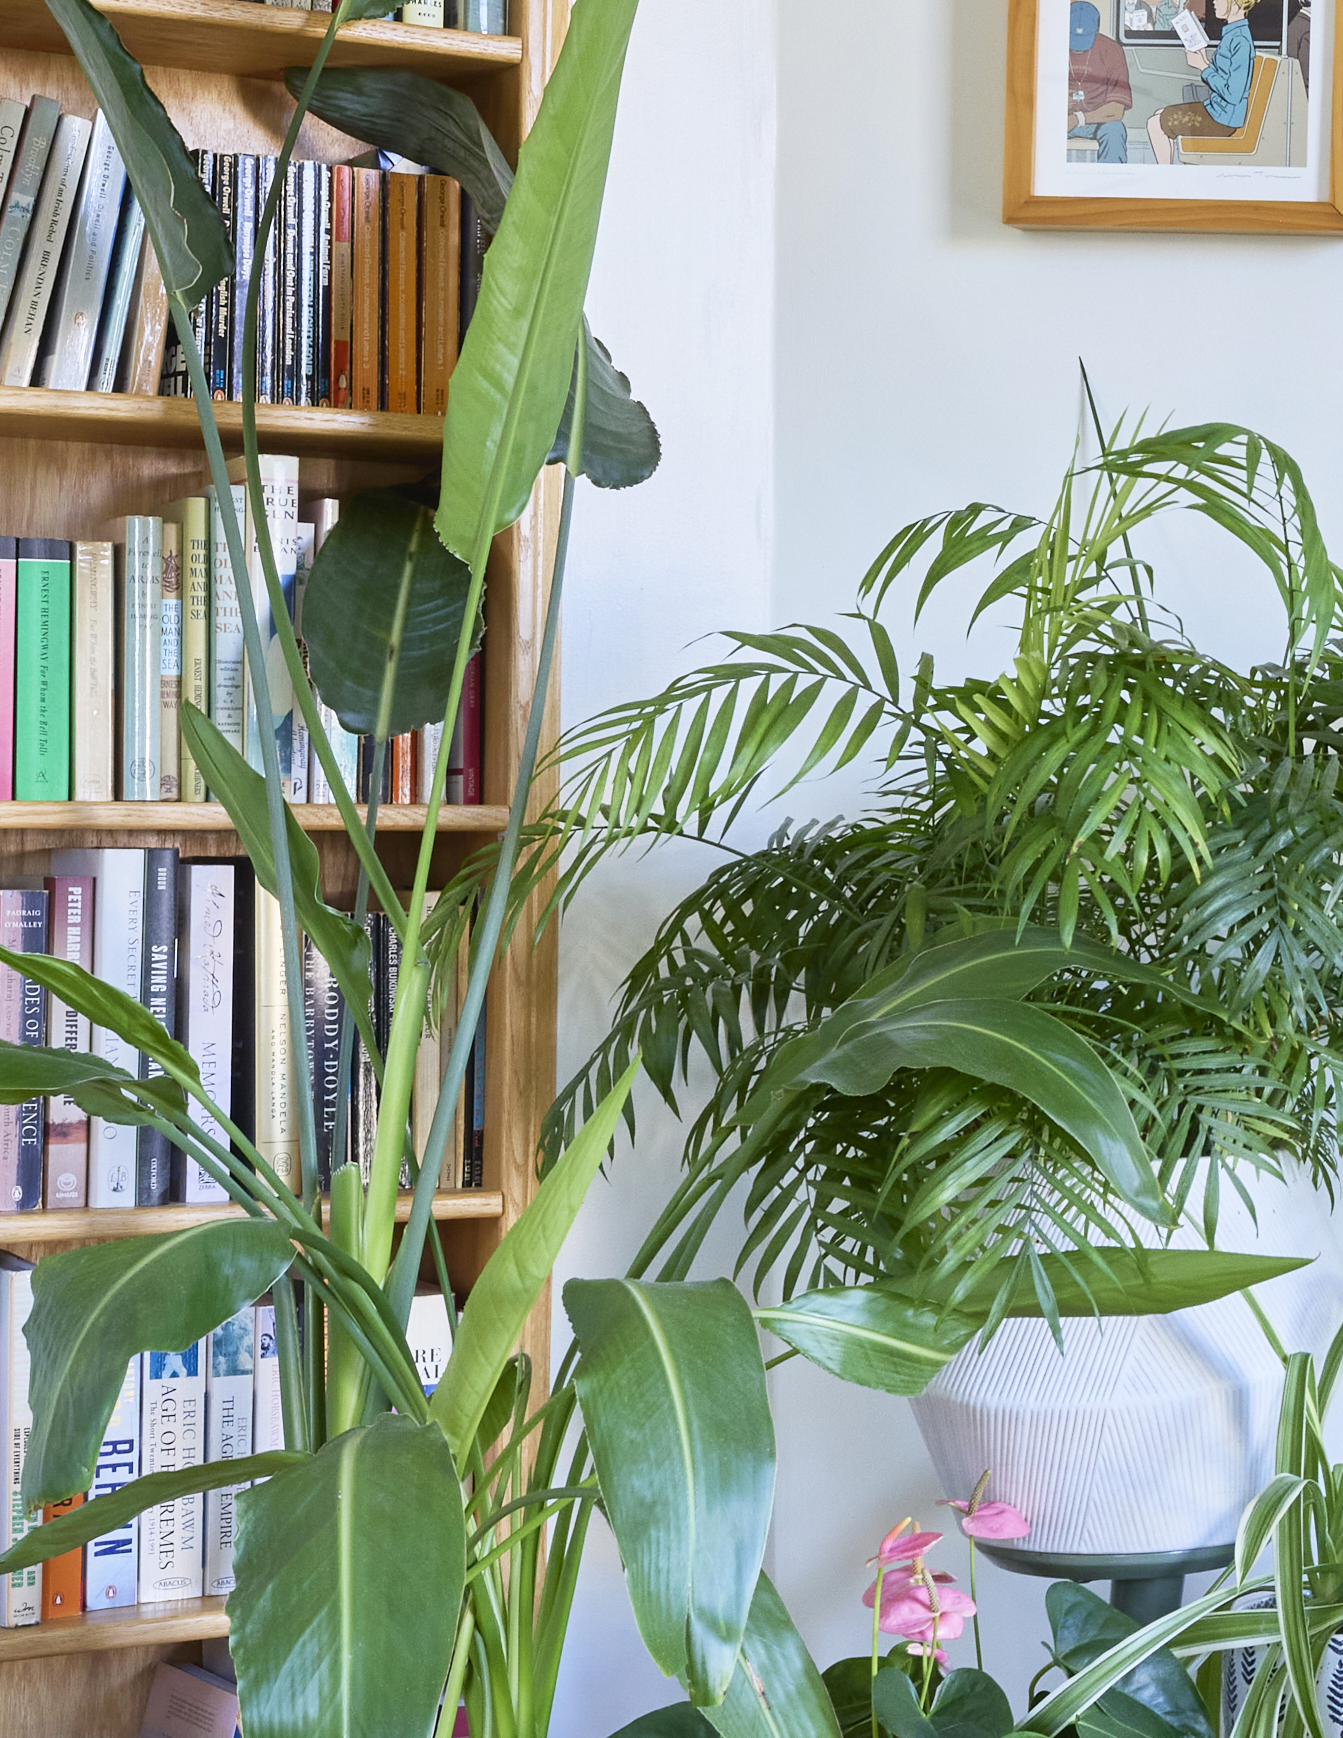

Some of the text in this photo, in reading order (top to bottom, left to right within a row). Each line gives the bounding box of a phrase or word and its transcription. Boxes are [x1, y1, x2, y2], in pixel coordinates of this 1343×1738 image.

[21, 136, 47, 186] Brooklyn
[221, 156, 231, 213] George Orwell
[84, 145, 115, 281] George Orwell Orwell and Politics
[241, 158, 254, 280] George Orwell Burmese Days
[23, 129, 81, 336] Confessions of an Irish Rebel BRENDAN BEHAN
[320, 171, 331, 285] George Orwell Animal Farm
[261, 485, 293, 495] THE
[190, 539, 208, 550] THE
[190, 555, 208, 565] OLD
[129, 575, 160, 584] ARMS
[190, 568, 208, 578] MAN
[190, 582, 208, 592] AND
[163, 603, 178, 612] THE
[190, 595, 208, 606] THE
[161, 614, 180, 625] OLD
[190, 609, 208, 620] SEA
[161, 627, 180, 636] MAN
[215, 623, 241, 633] SEA
[162, 638, 178, 646] AND
[163, 647, 178, 657] THE
[39, 571, 49, 756] ERNEST HEMINGWAY For Whom the Bell Tolls
[162, 659, 180, 670] SEA
[297, 724, 307, 769] Hemingway
[157, 868, 167, 891] BROUN
[127, 890, 140, 988] EVERY SECRET
[388, 927, 397, 1013] CHARLES BUKOWSKI
[323, 978, 339, 1132] RODDY DOYLE
[279, 1013, 287, 1135] NELSON MANDELA
[150, 1158, 158, 1190] OXFORD
[237, 1417, 248, 1443] ERIC
[271, 1390, 279, 1447] HOBSBAWM
[220, 1396, 234, 1550] THE AGE EMPIRE
